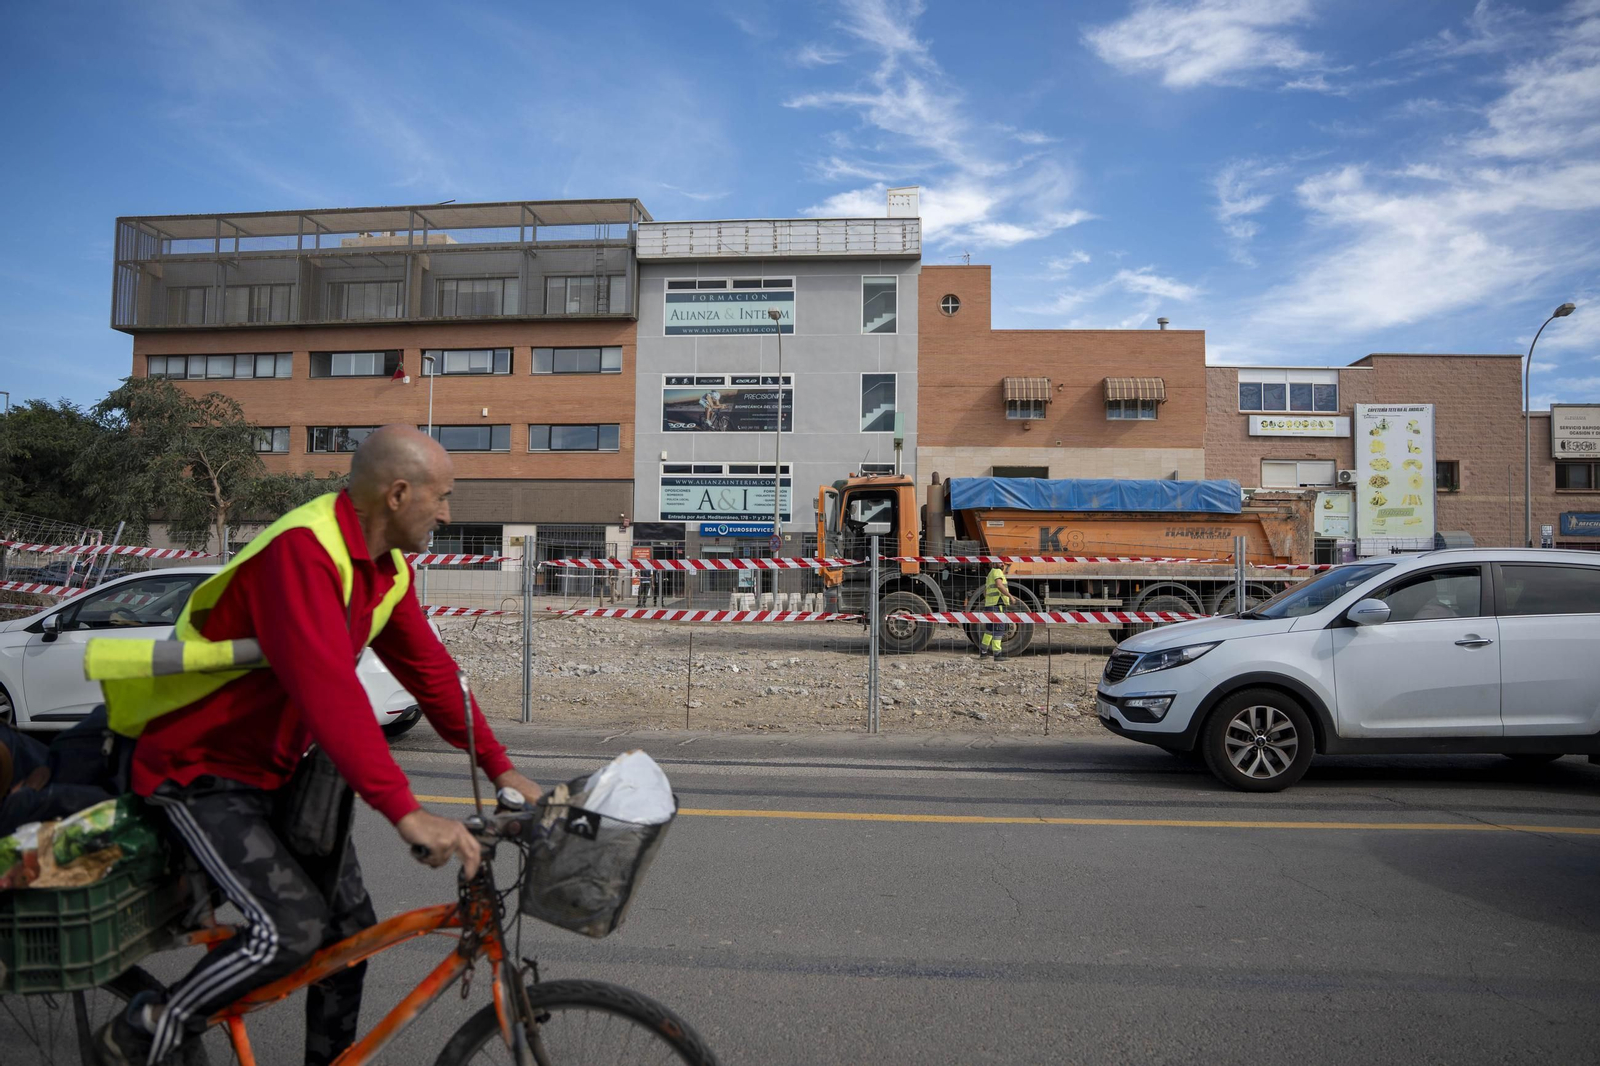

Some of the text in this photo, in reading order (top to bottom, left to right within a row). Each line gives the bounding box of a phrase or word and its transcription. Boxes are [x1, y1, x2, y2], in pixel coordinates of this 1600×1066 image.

[692, 293, 768, 301] FORMACIÓN
[670, 307, 790, 320] ALIANZA & INTEM
